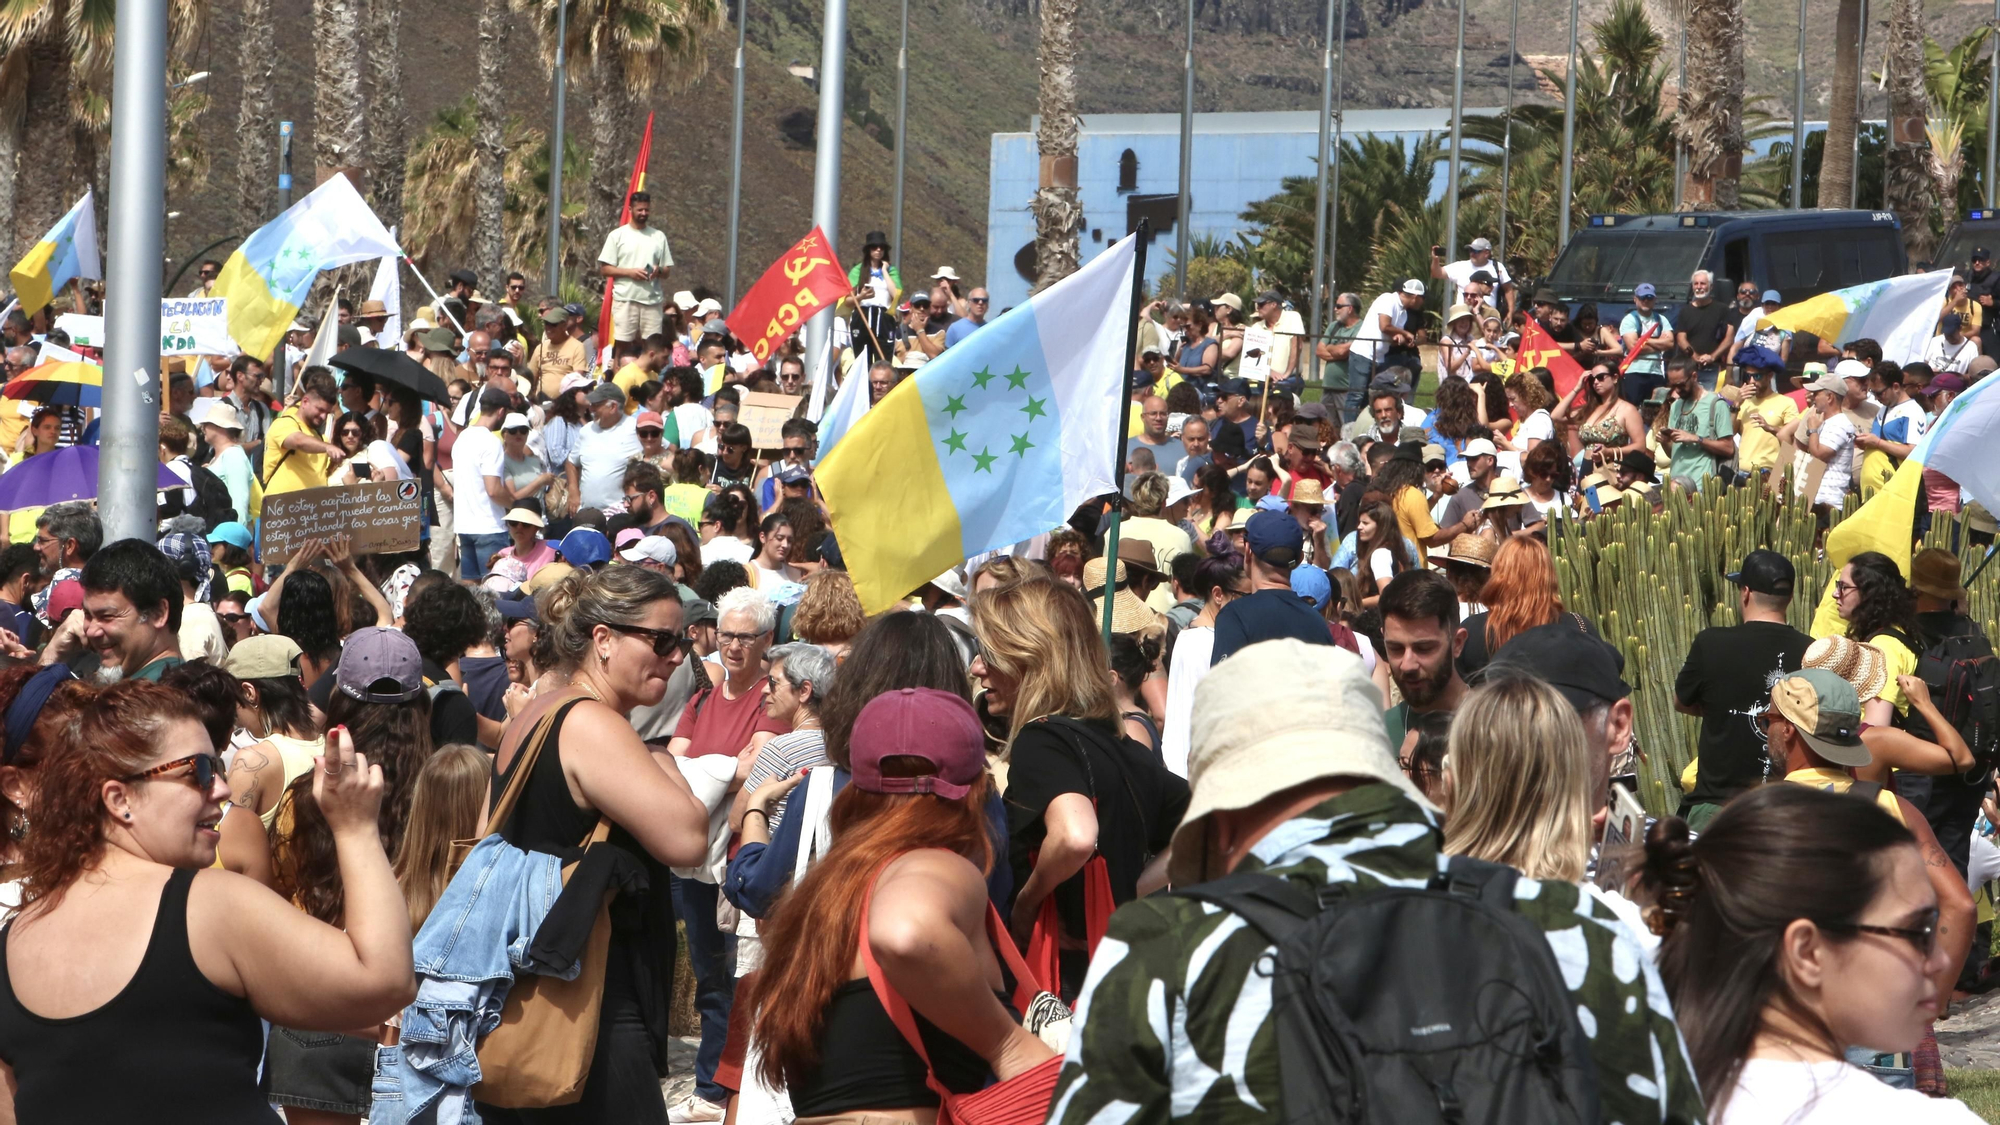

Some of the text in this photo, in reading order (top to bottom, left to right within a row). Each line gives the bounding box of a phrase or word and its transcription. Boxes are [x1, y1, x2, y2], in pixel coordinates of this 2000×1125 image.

[266, 517, 296, 529] cosas
[300, 513, 318, 527] que
[338, 506, 375, 522] puedo
[378, 502, 419, 514] cambiar
[267, 489, 391, 516] No estoy aceptando las
[266, 514, 418, 544] estoy cambiando las cosas que
[267, 546, 279, 555] no
[283, 537, 306, 555] pued
